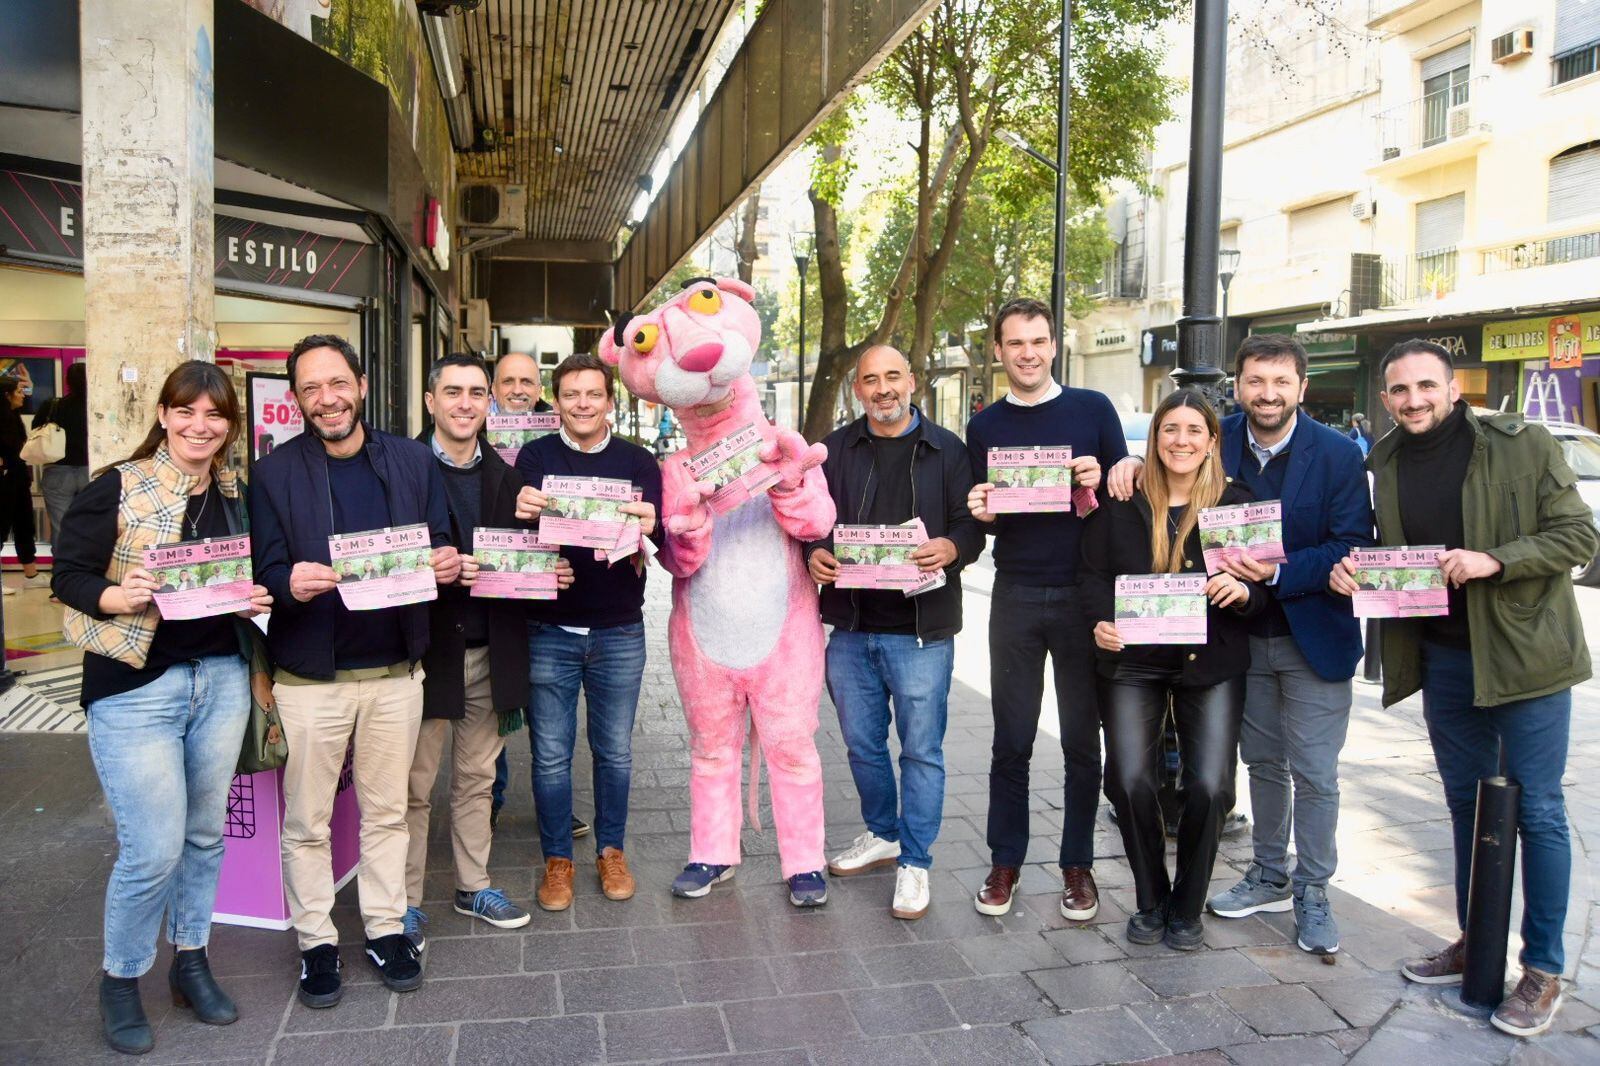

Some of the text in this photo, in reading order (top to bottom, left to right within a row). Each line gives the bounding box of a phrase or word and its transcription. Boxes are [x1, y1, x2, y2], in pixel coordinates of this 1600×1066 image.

[228, 236, 318, 275] ESTILO
[1096, 334, 1126, 347] PARAISO
[725, 429, 756, 451] SOMOS
[992, 452, 1025, 461] SOMOS
[1034, 452, 1067, 460] SOMOS
[690, 451, 720, 473] SOMOS
[547, 482, 582, 490] SOMOS
[592, 483, 626, 494] SOMOS
[1203, 511, 1236, 522] SOMOS
[1244, 506, 1276, 517] SOMOS
[384, 531, 424, 545] SOMOS
[479, 534, 513, 543] SOMOS
[880, 531, 913, 539] SOMOS
[204, 541, 246, 554] SOMOS
[335, 538, 375, 552] SOMOS
[149, 548, 193, 562] SOMOS
[1353, 553, 1391, 561] SOMOS
[1120, 582, 1155, 590] SOMOS
[1164, 580, 1200, 588] SOMOS
